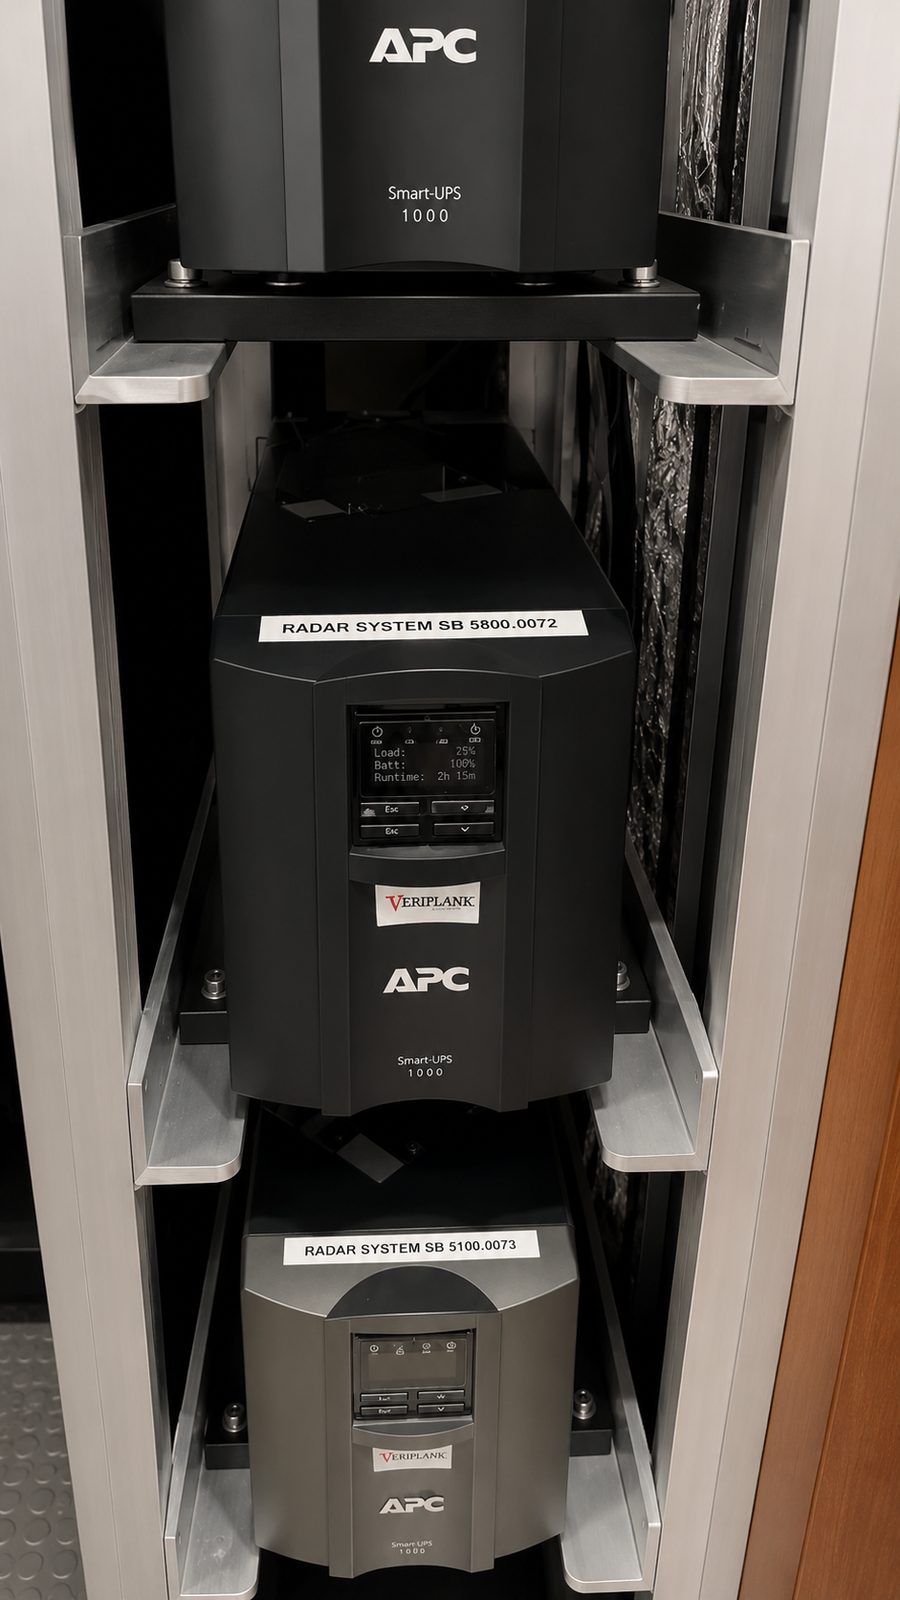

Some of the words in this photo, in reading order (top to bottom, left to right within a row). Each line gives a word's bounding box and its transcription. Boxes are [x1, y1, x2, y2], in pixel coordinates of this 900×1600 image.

[369, 28, 477, 64] APC
[388, 186, 462, 201] Smart-UPS
[402, 209, 449, 223] 1000
[282, 621, 349, 634] RADAR
[356, 620, 433, 633] SYSTEM
[438, 619, 464, 631] SB
[470, 618, 558, 630] 5800.0072
[374, 748, 405, 758] Load:
[456, 746, 476, 756] 25%
[374, 760, 405, 770] Batt:
[374, 772, 424, 782] Runtime:
[437, 771, 450, 781] 2h
[457, 771, 476, 780] 15m
[385, 895, 475, 912] VERIPLANK
[383, 966, 470, 993] APC
[398, 1054, 453, 1066] Smart-UPS
[409, 1068, 443, 1077] 1000
[305, 1245, 356, 1256] RADAR
[361, 1243, 420, 1255] SYSTEM
[425, 1242, 445, 1253] SB
[449, 1239, 517, 1251] 5100.0073
[379, 1451, 447, 1463] VERIPLANK
[379, 1496, 445, 1514] APC
